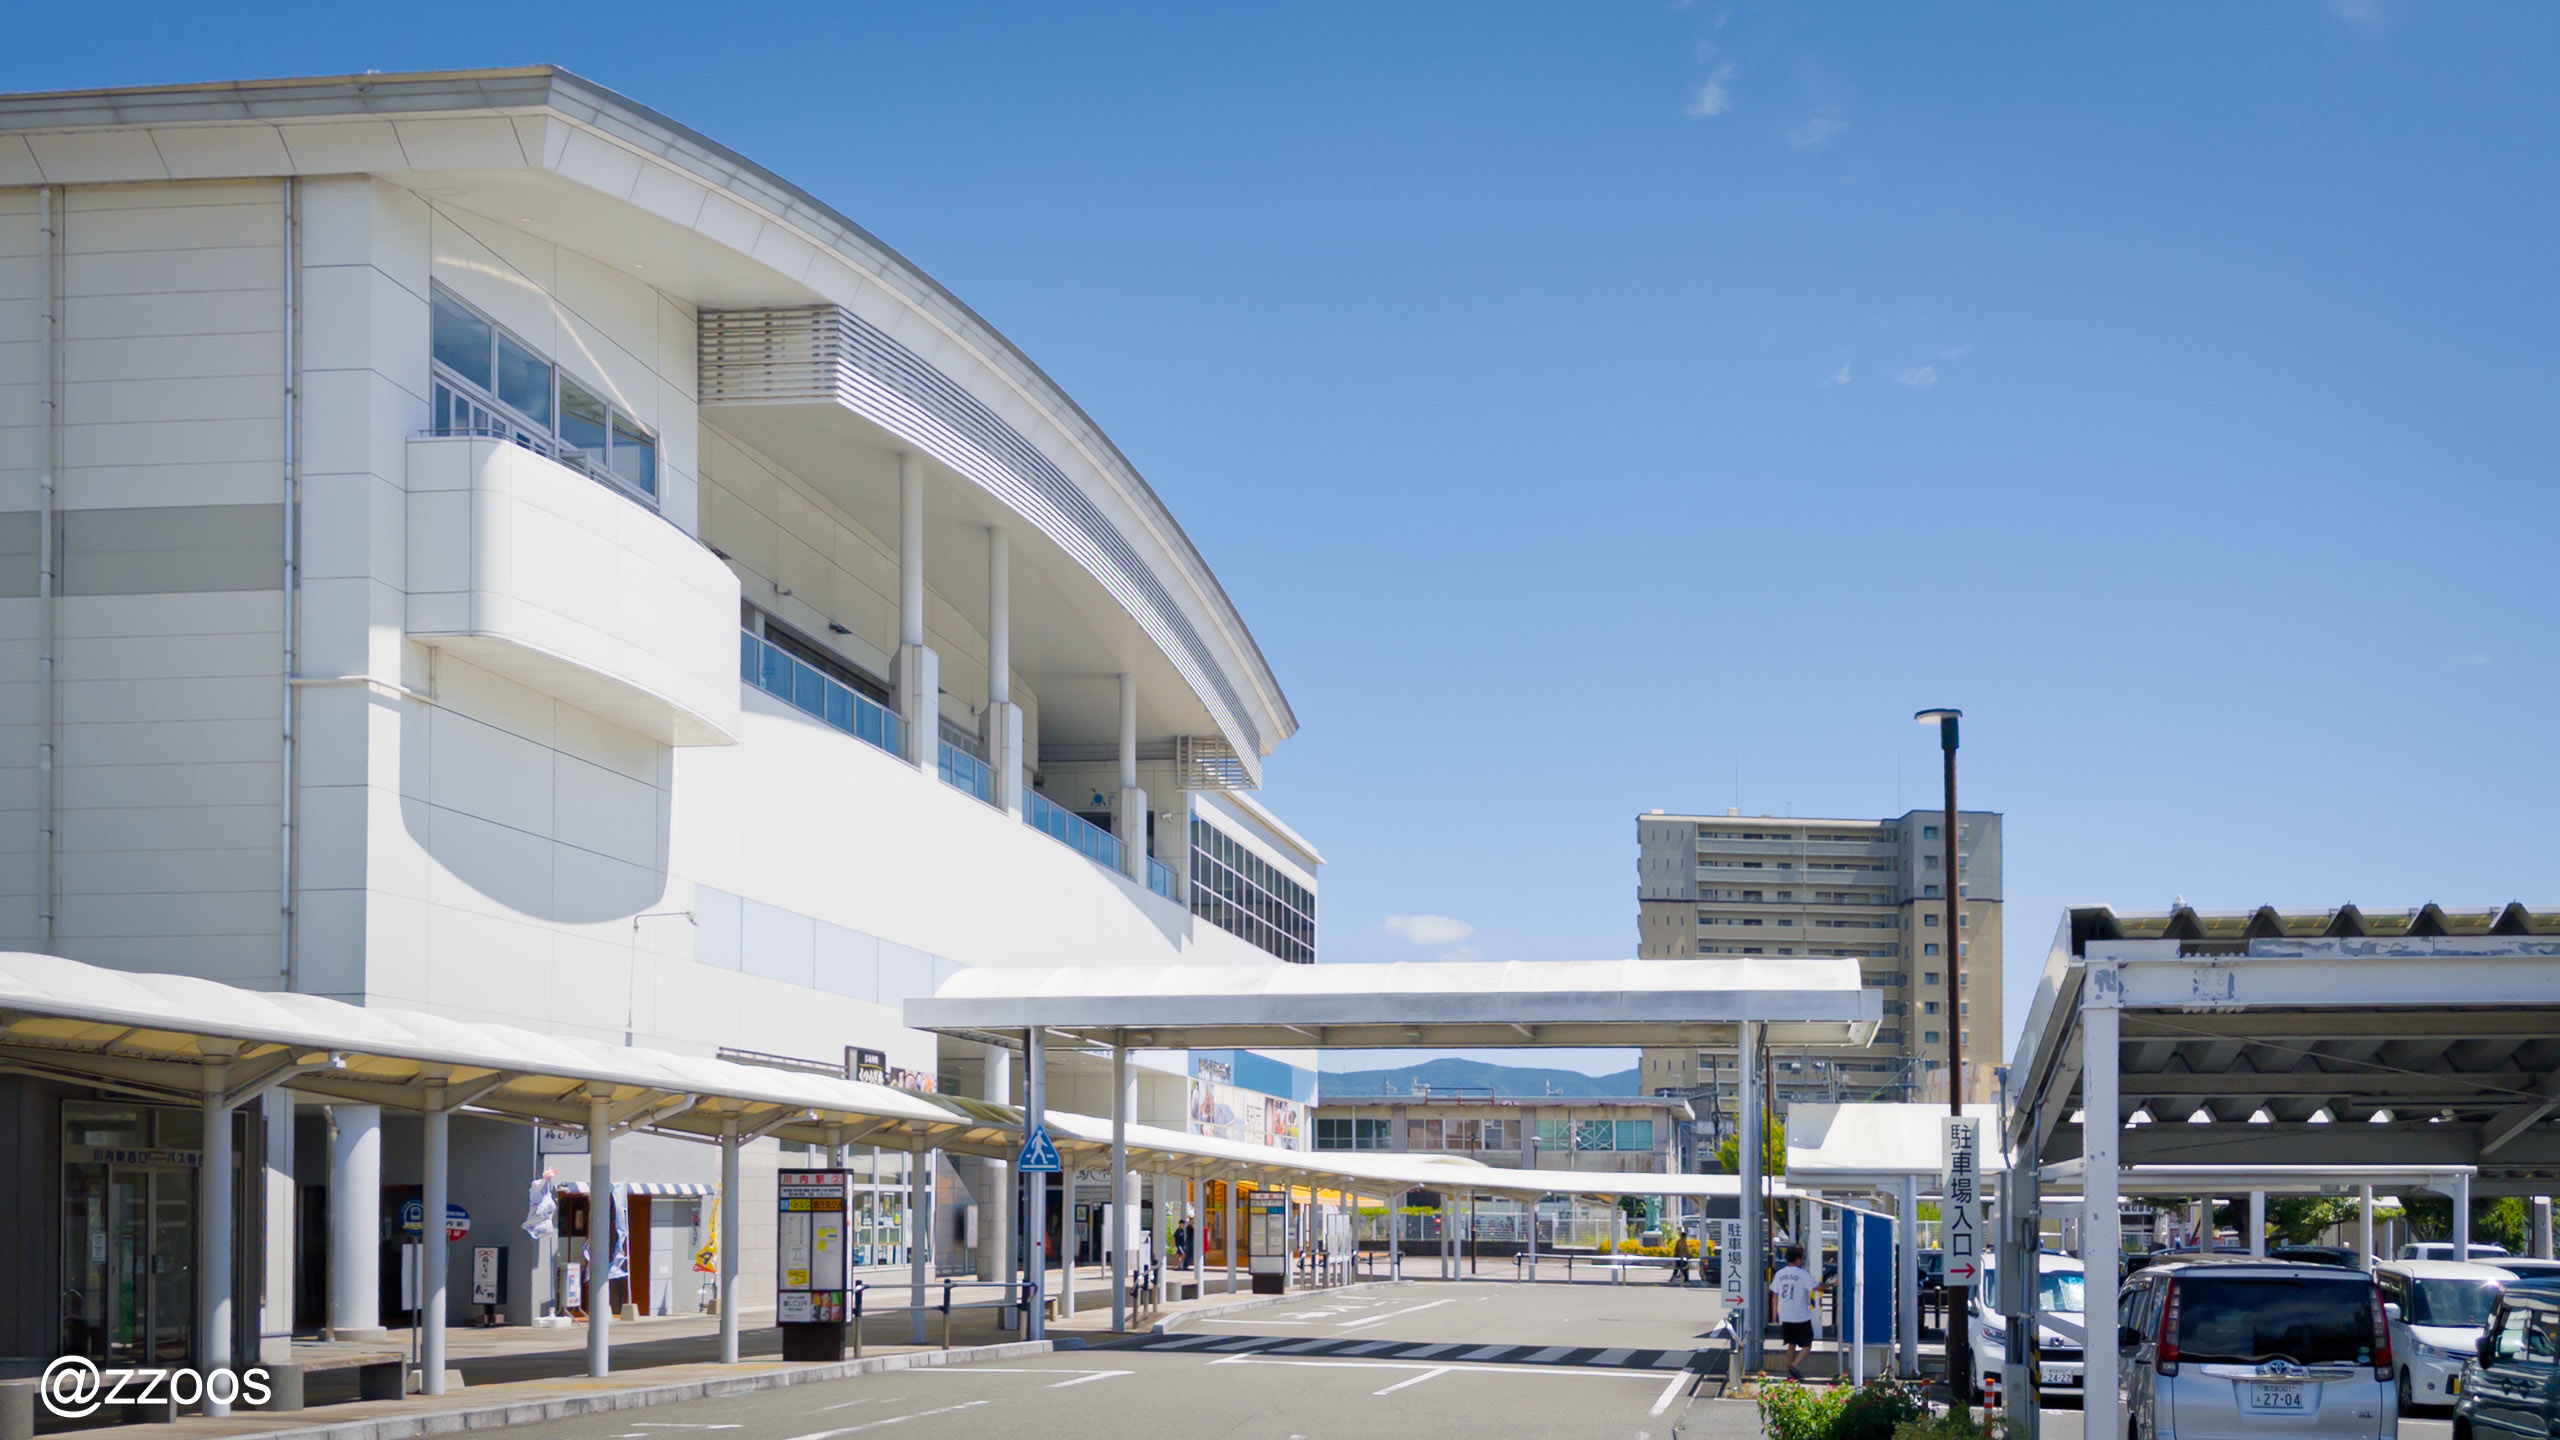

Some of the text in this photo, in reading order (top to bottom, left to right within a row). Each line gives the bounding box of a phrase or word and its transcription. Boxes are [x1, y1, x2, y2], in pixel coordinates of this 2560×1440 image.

[1950, 1124, 1973, 1257] 駐車場入口
[1727, 1223, 1742, 1293] 駐車場入口
[2264, 1393, 2301, 1407] 27-04
